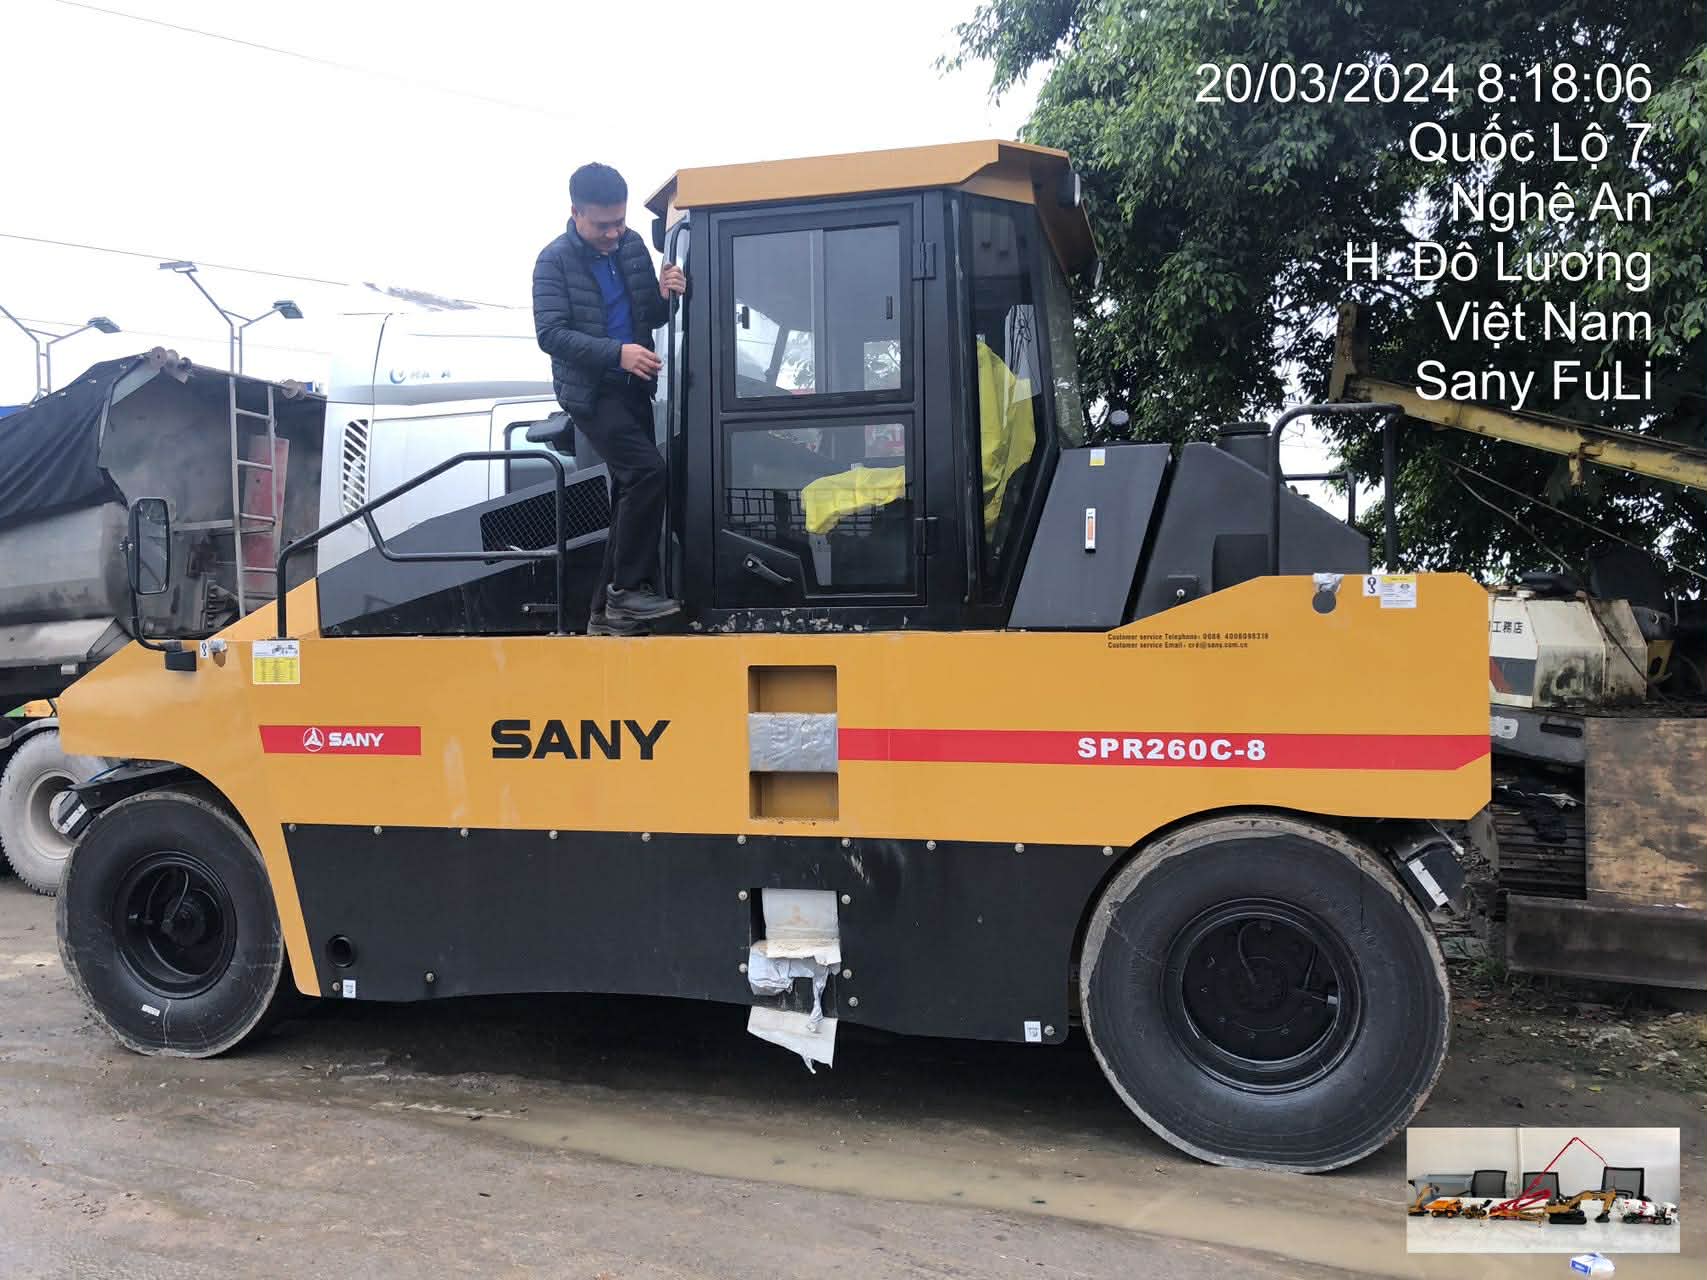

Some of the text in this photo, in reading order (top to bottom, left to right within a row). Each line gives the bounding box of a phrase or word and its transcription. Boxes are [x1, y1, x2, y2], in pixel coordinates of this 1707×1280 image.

[1107, 633, 1138, 641] Customer
[1139, 633, 1163, 641] service
[1107, 641, 1138, 649] Customer
[1139, 641, 1163, 649] service
[328, 732, 384, 748] SANY
[491, 719, 671, 760] SANY
[1077, 737, 1266, 761] SPR260C-8
